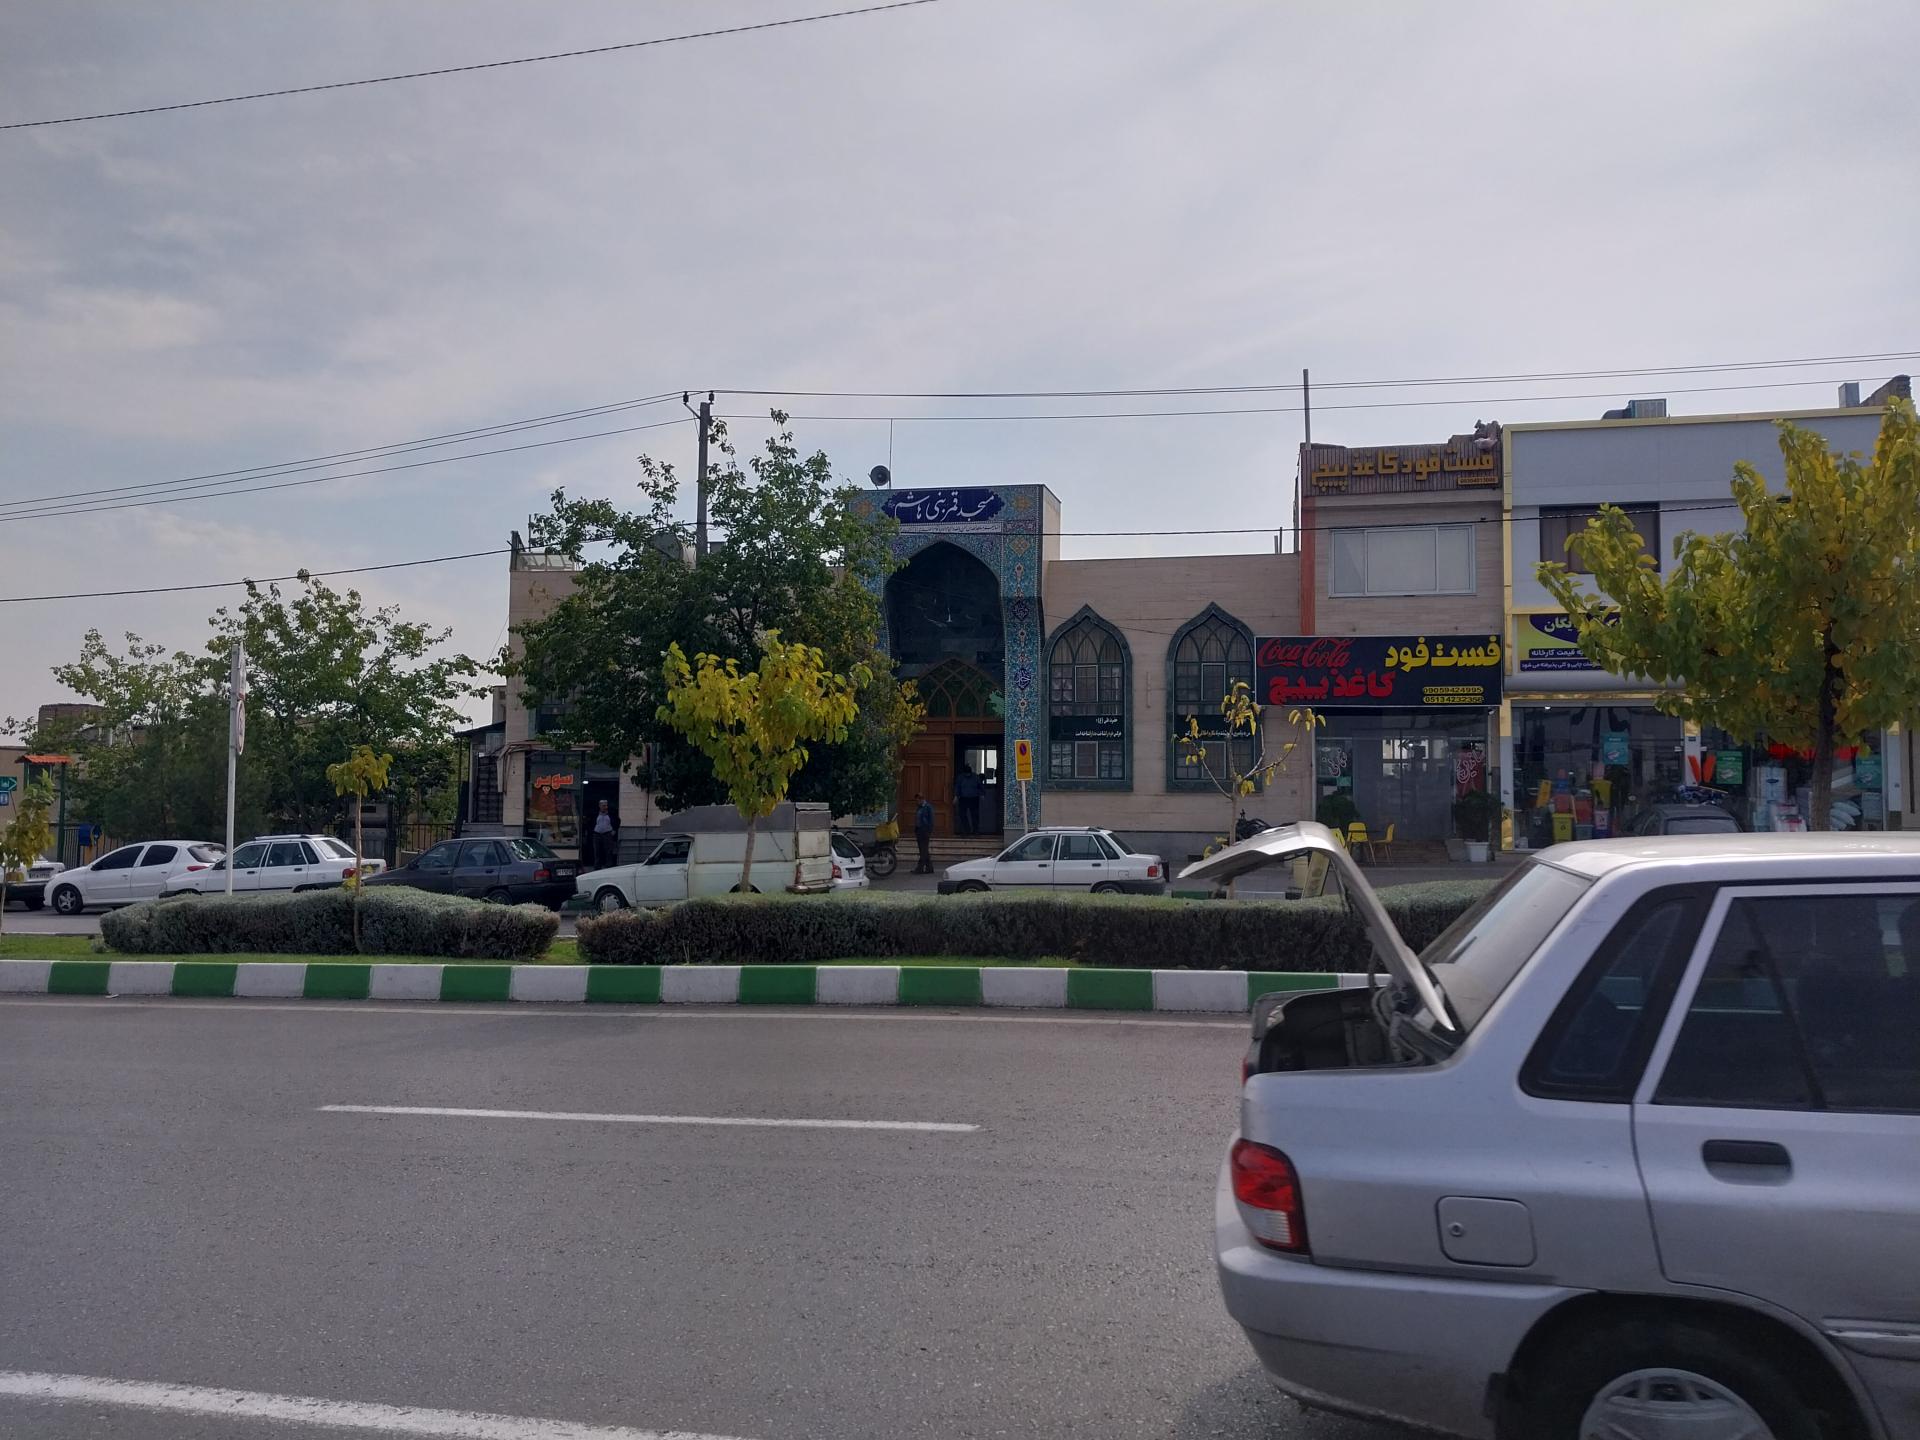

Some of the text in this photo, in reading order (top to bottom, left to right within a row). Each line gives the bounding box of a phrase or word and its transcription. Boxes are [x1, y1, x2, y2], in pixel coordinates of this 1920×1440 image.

[1352, 450, 1400, 475] کاغذ
[1401, 449, 1441, 481] فود
[1444, 447, 1494, 472] فست
[894, 491, 995, 521] مسجد قمر بنی هاشم
[1385, 635, 1500, 672] فست فود
[1531, 649, 1555, 658] کارخانه
[1268, 667, 1397, 705] کاغذ پیچ
[534, 773, 574, 795] سوپر
